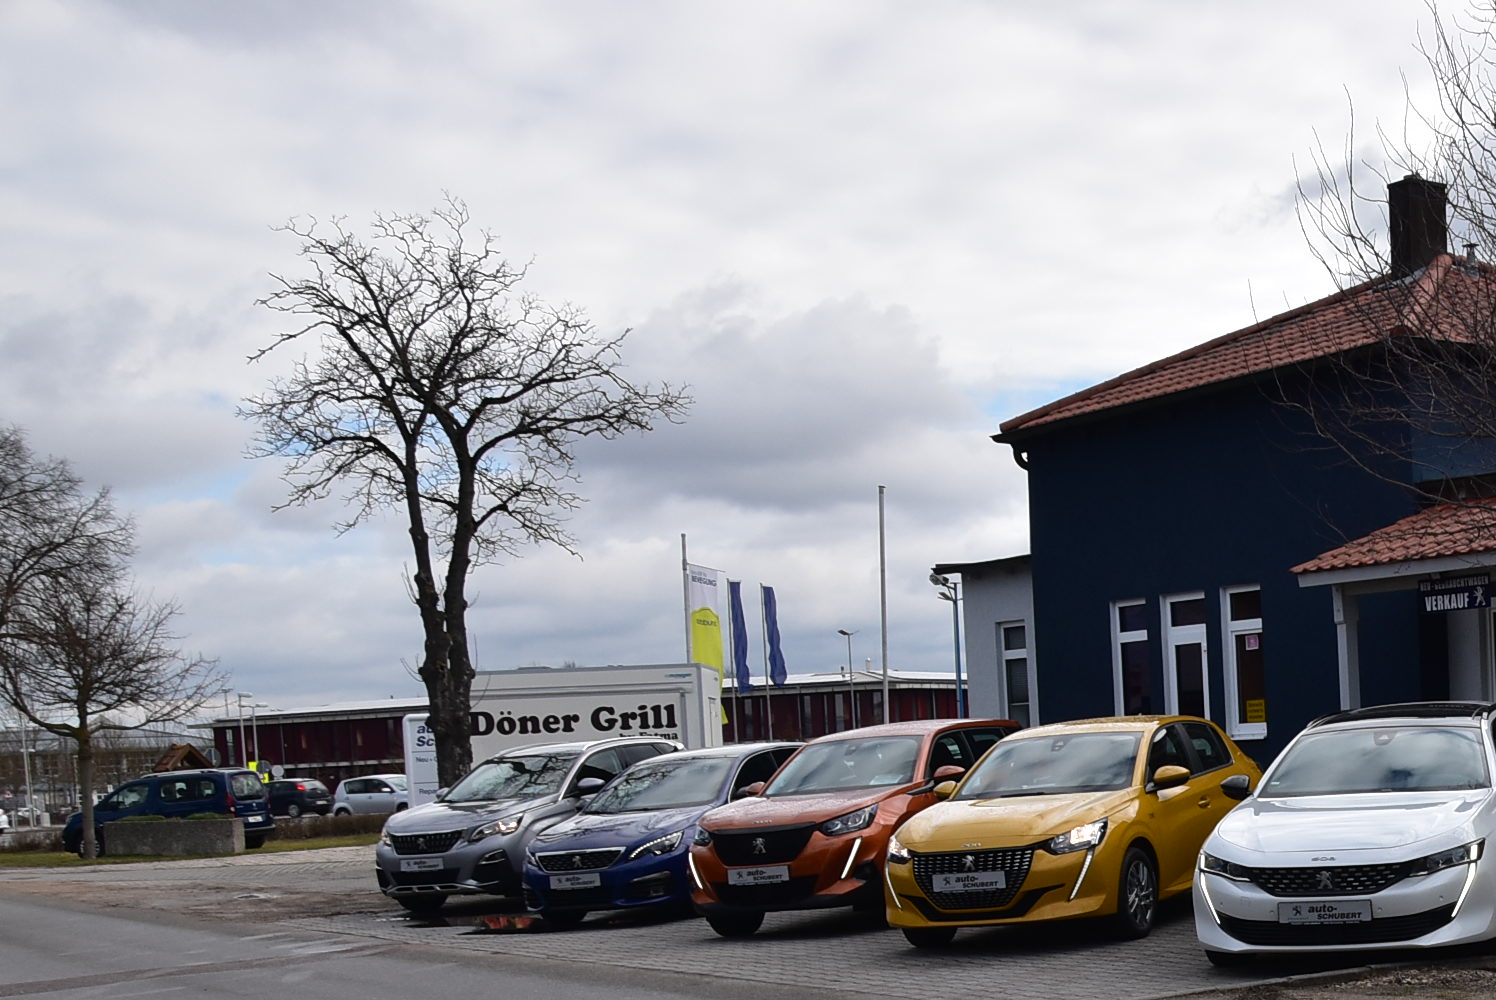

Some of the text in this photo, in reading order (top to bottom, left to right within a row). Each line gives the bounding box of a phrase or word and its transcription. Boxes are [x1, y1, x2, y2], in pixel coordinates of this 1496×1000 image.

[1425, 592, 1469, 611] VERKAUF
[469, 703, 678, 736] Döner Grill
[954, 874, 979, 883] auto-
[962, 880, 999, 889] SCHUBERT
[1307, 904, 1338, 913] auto-
[1316, 912, 1362, 921] SCHUBERT
